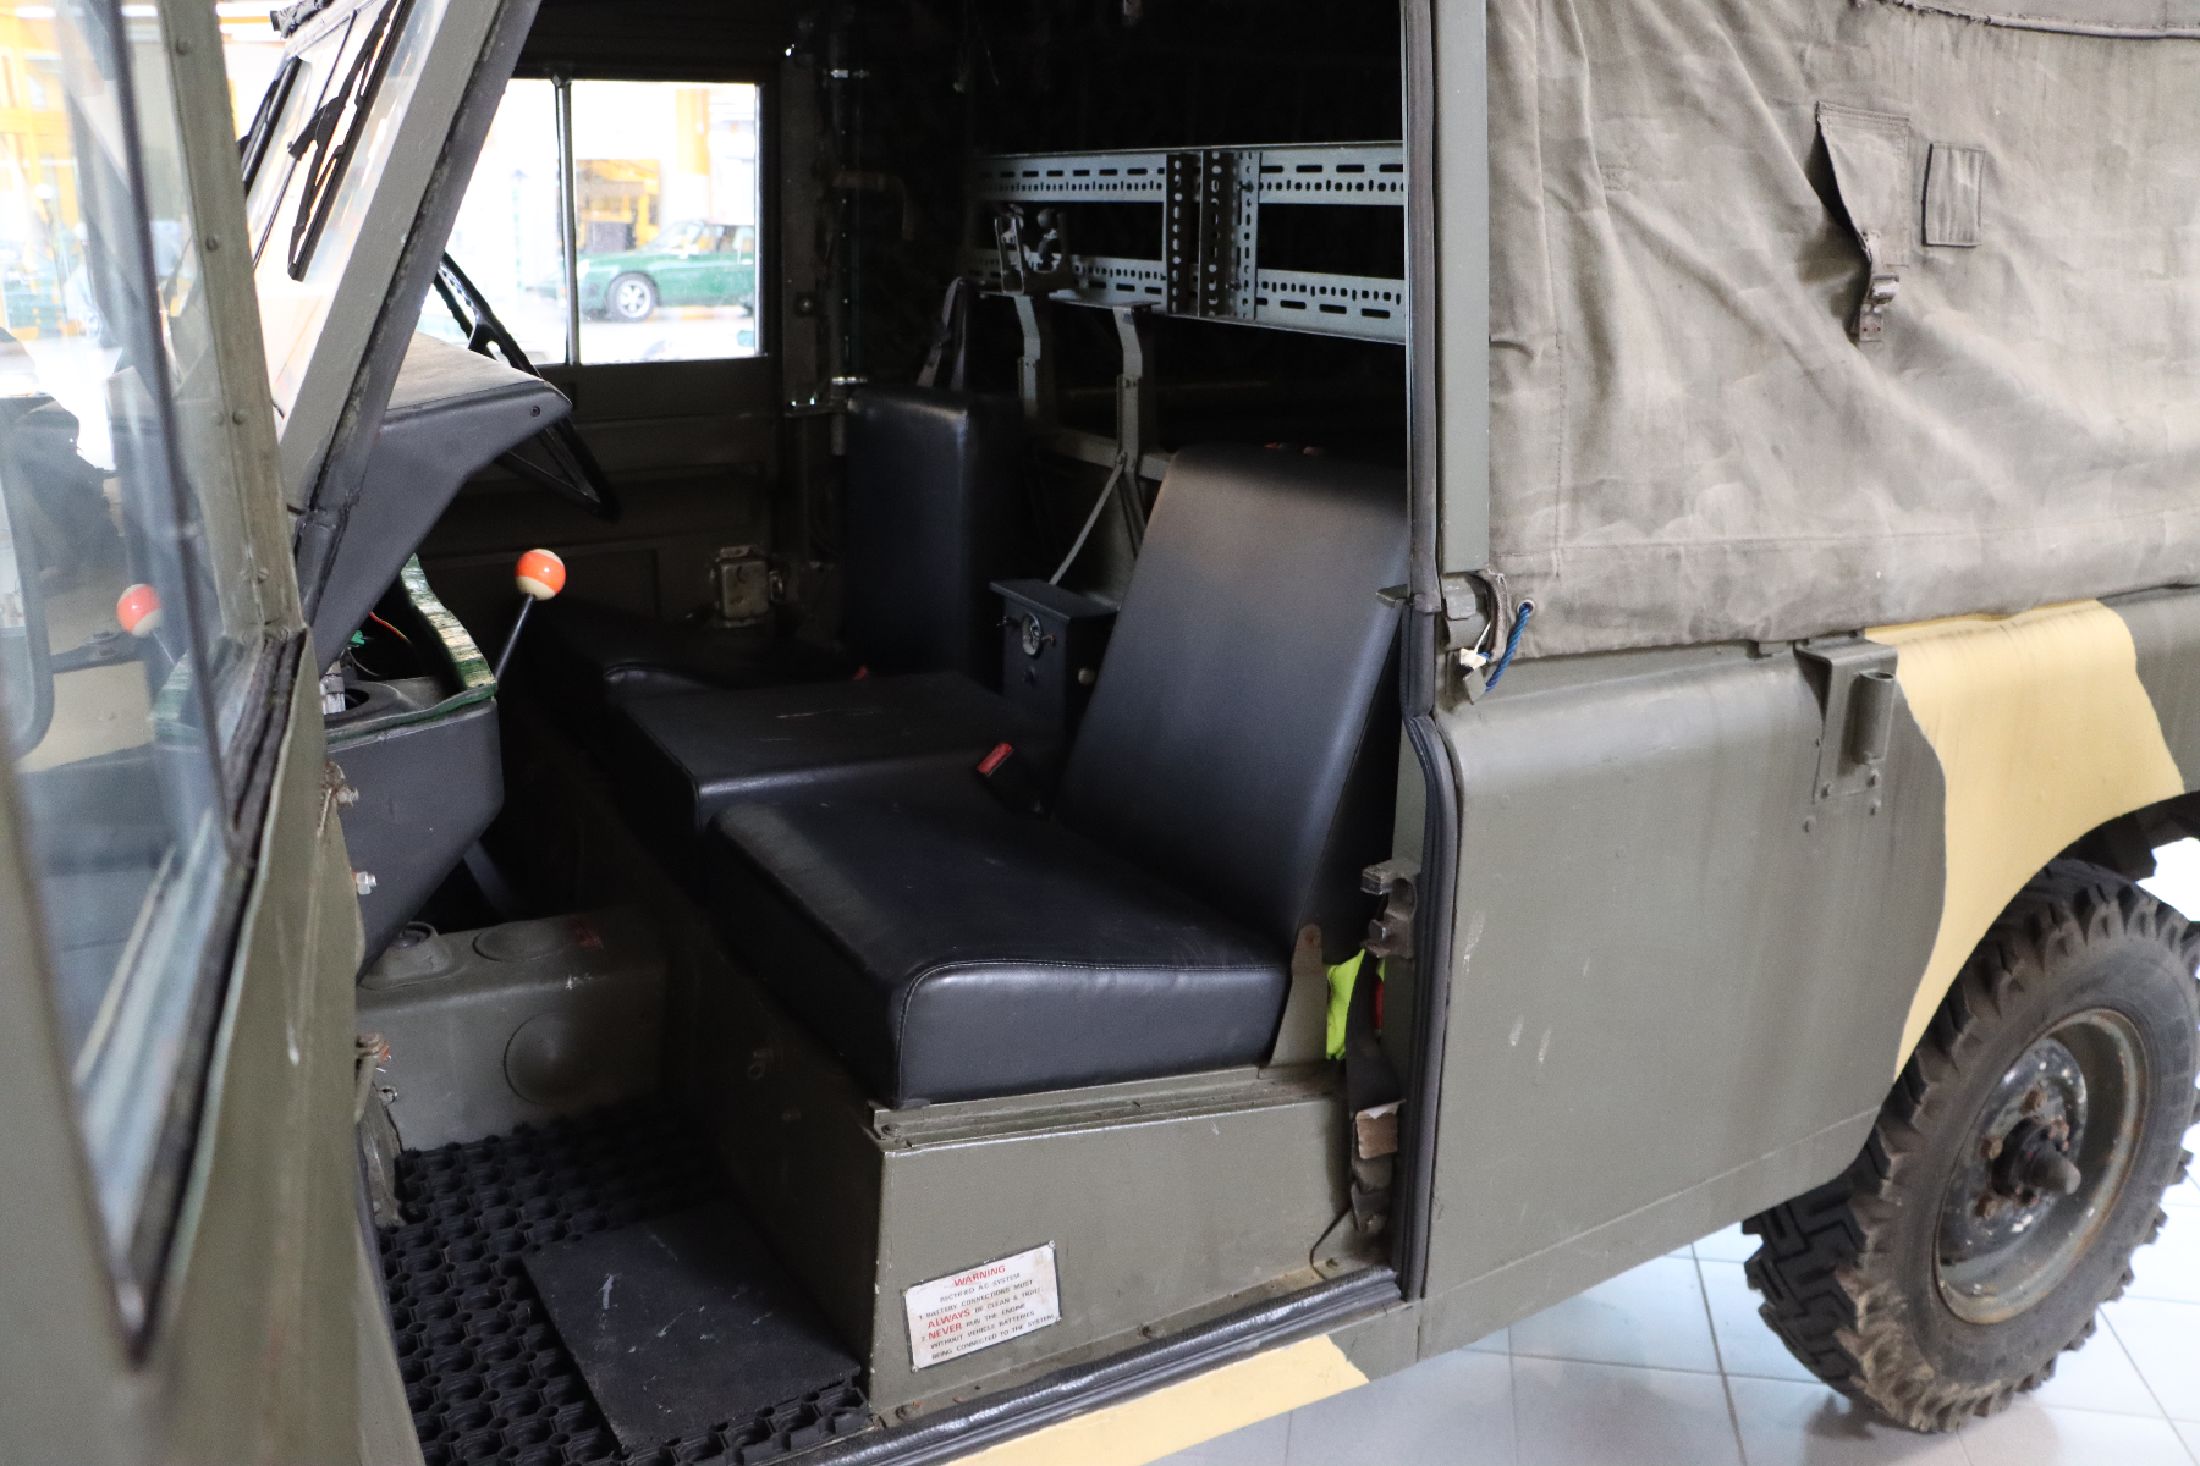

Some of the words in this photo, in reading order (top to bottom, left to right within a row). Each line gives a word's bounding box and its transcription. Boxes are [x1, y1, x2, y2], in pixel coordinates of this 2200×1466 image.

[954, 1265, 1006, 1287] WARNING
[928, 1309, 970, 1328] ALWAYS
[928, 1322, 962, 1340] NEVER
